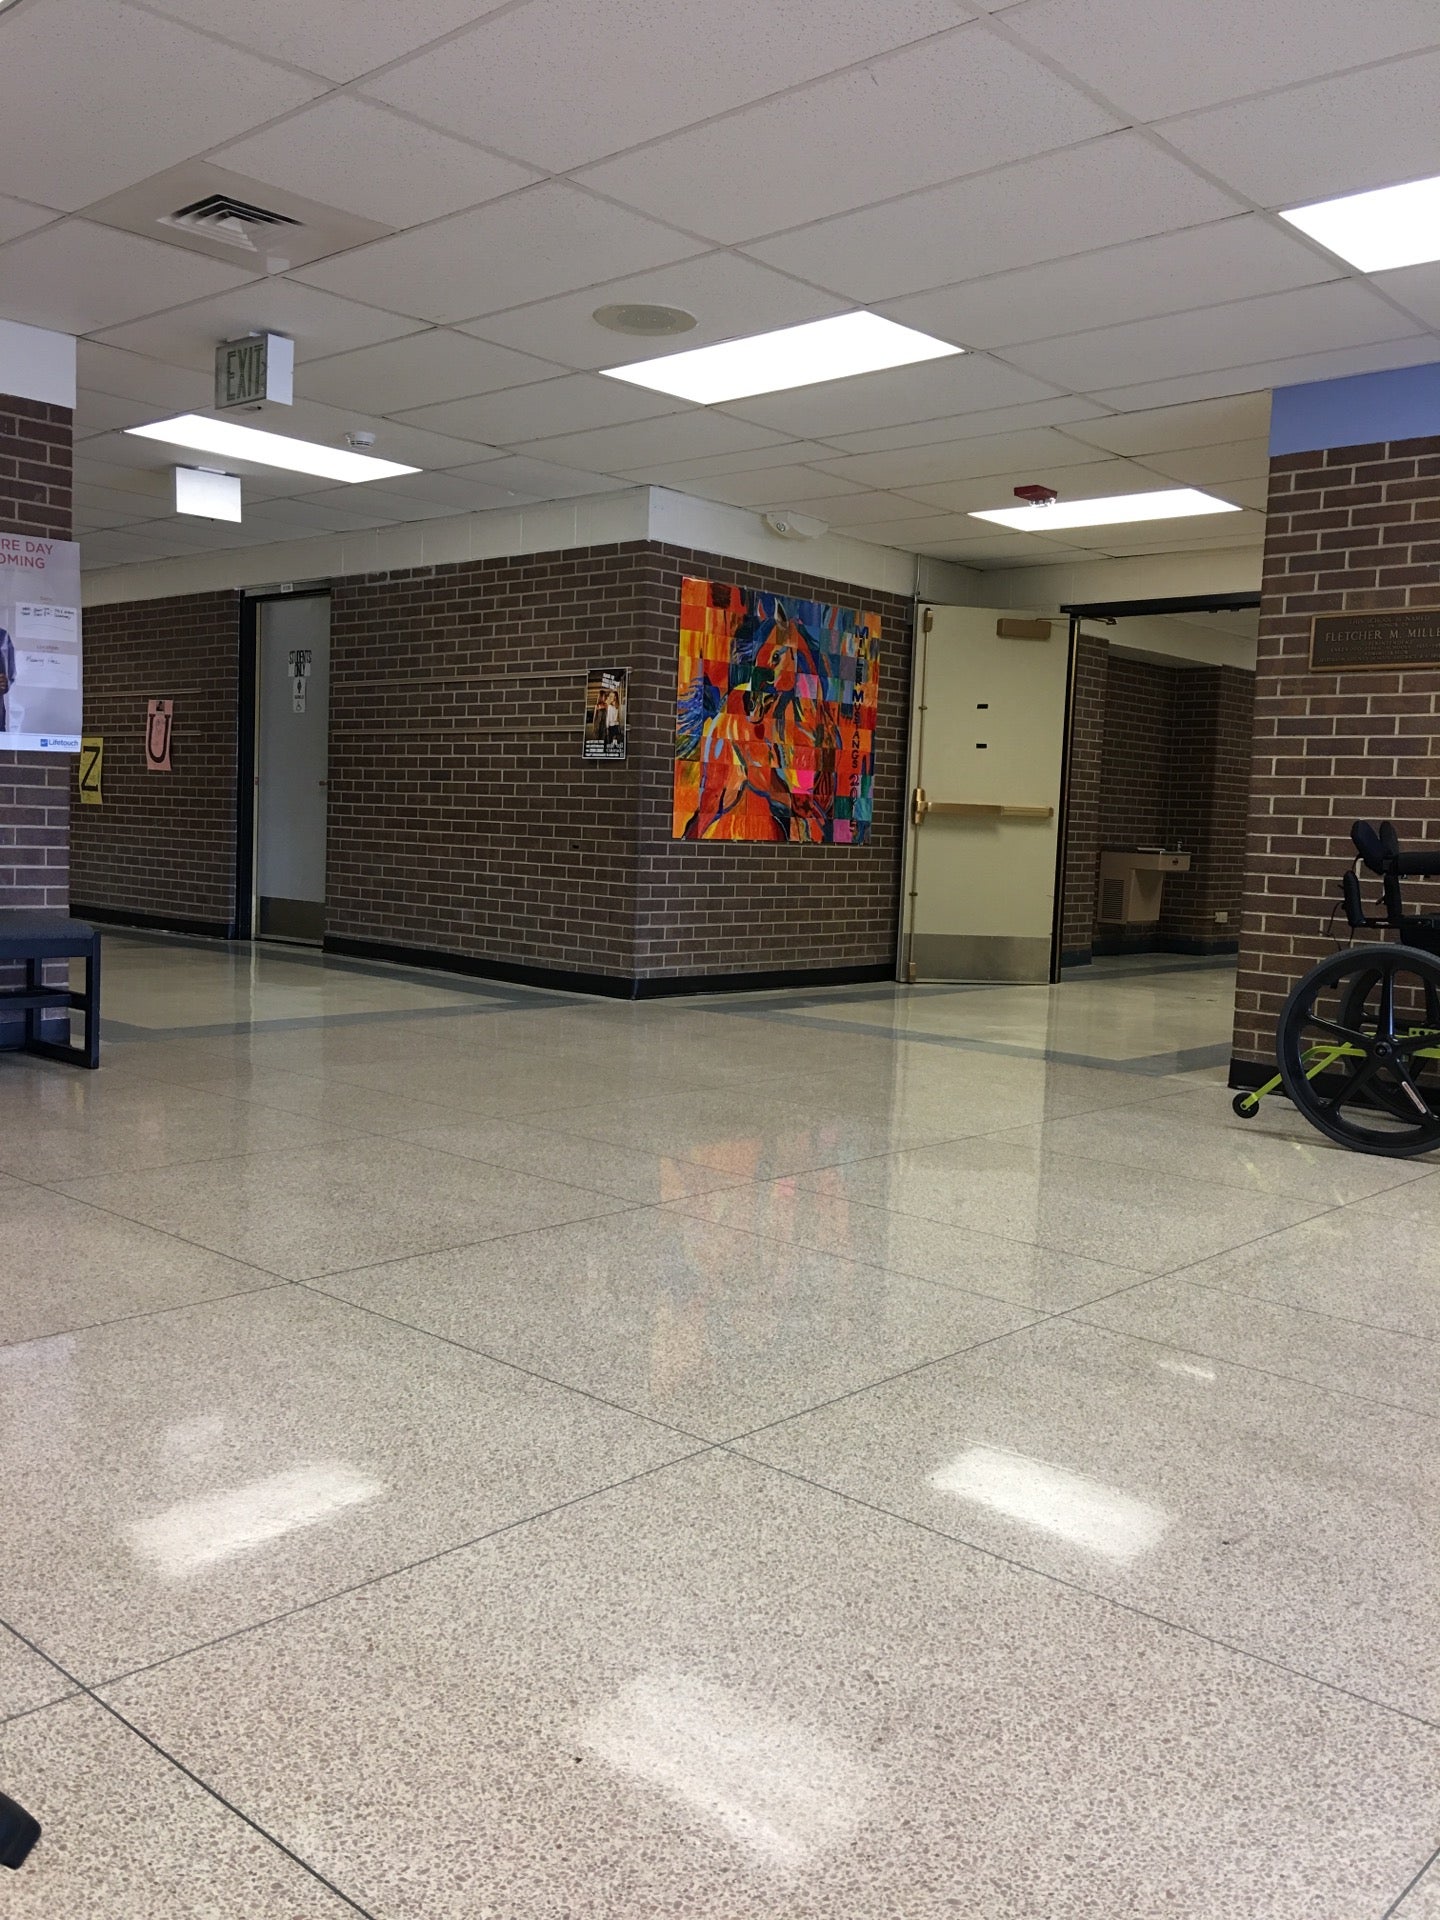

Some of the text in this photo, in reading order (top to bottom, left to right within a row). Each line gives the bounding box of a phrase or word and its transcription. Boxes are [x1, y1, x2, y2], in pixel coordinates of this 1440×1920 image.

[227, 344, 264, 402] EXIT
[25, 541, 54, 555] DAY
[1325, 630, 1382, 642] FLETCHER
[1389, 629, 1402, 639] M.
[48, 738, 79, 747] Lifetouch
[149, 713, 171, 764] U
[81, 745, 101, 792] Z
